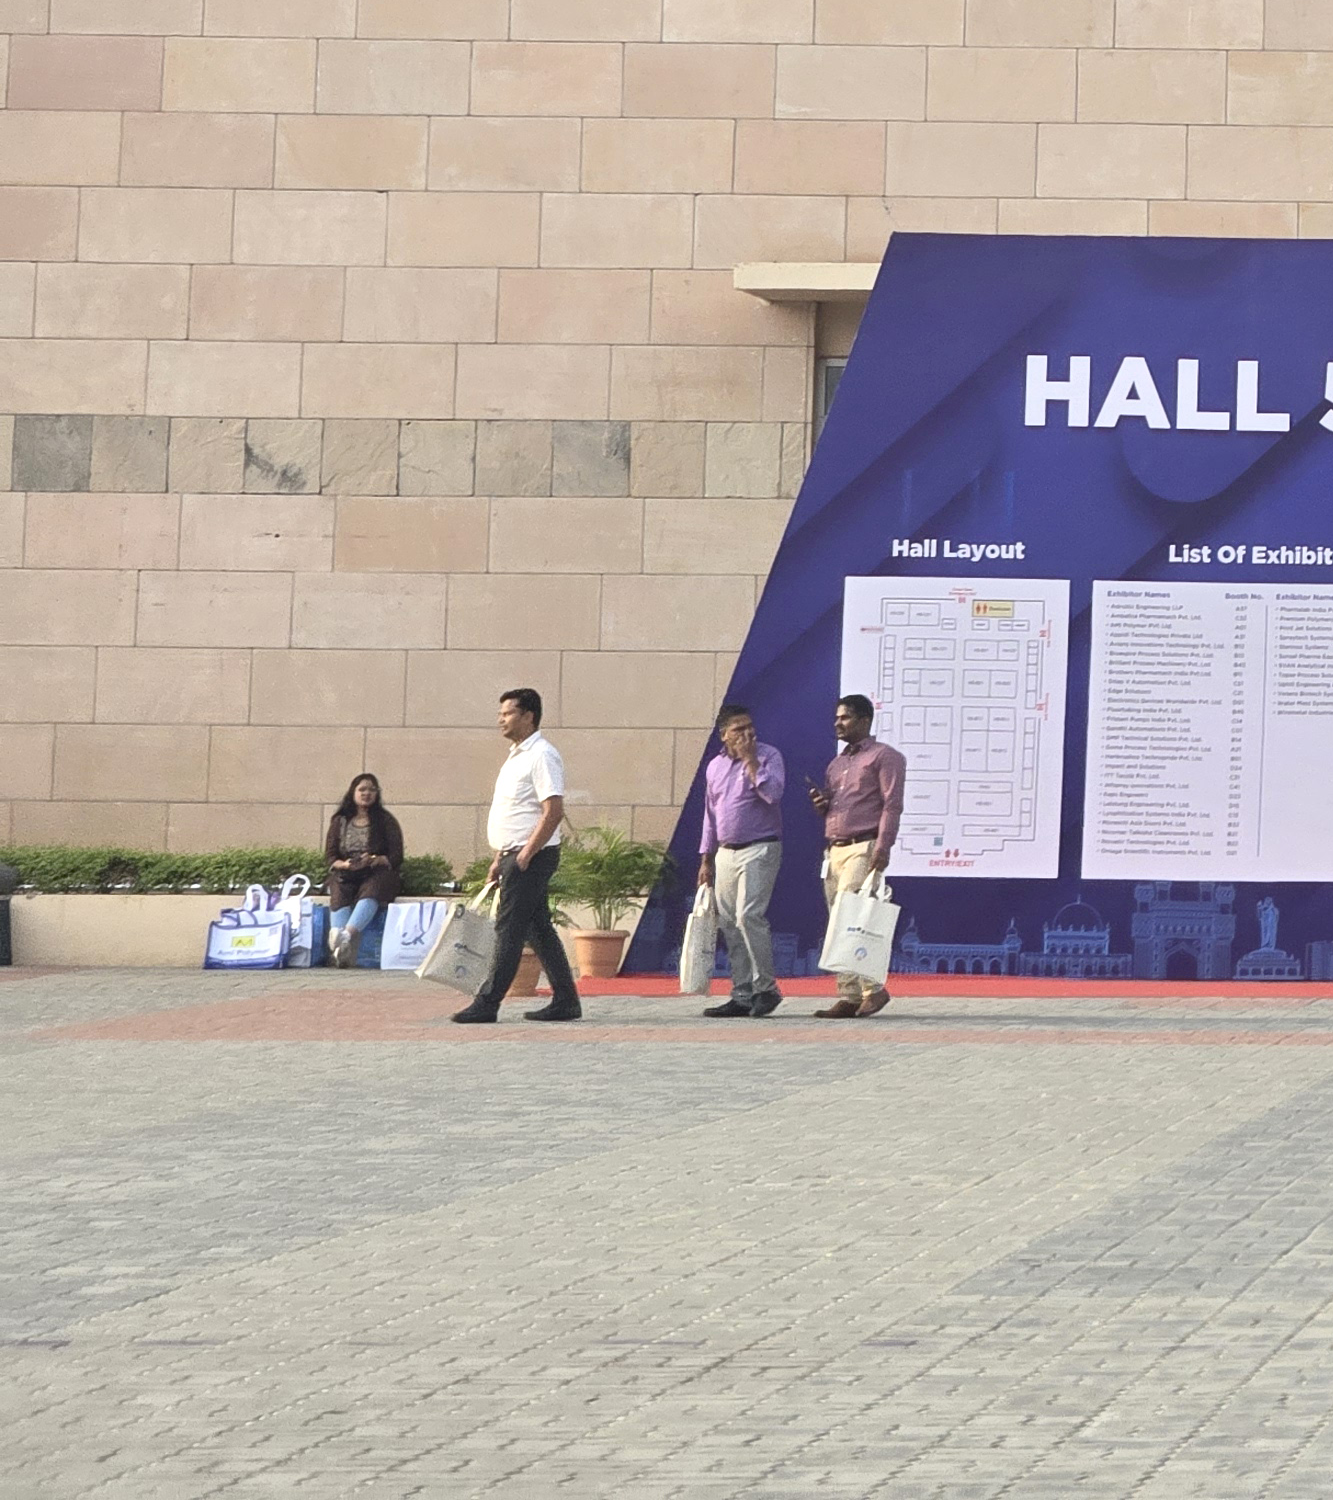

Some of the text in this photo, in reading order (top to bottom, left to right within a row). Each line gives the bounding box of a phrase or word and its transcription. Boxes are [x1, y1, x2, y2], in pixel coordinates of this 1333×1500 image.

[1025, 355, 1290, 431] HALL
[893, 539, 1025, 561] Hall Layout
[1169, 544, 1211, 563] List
[1218, 546, 1246, 563] Of
